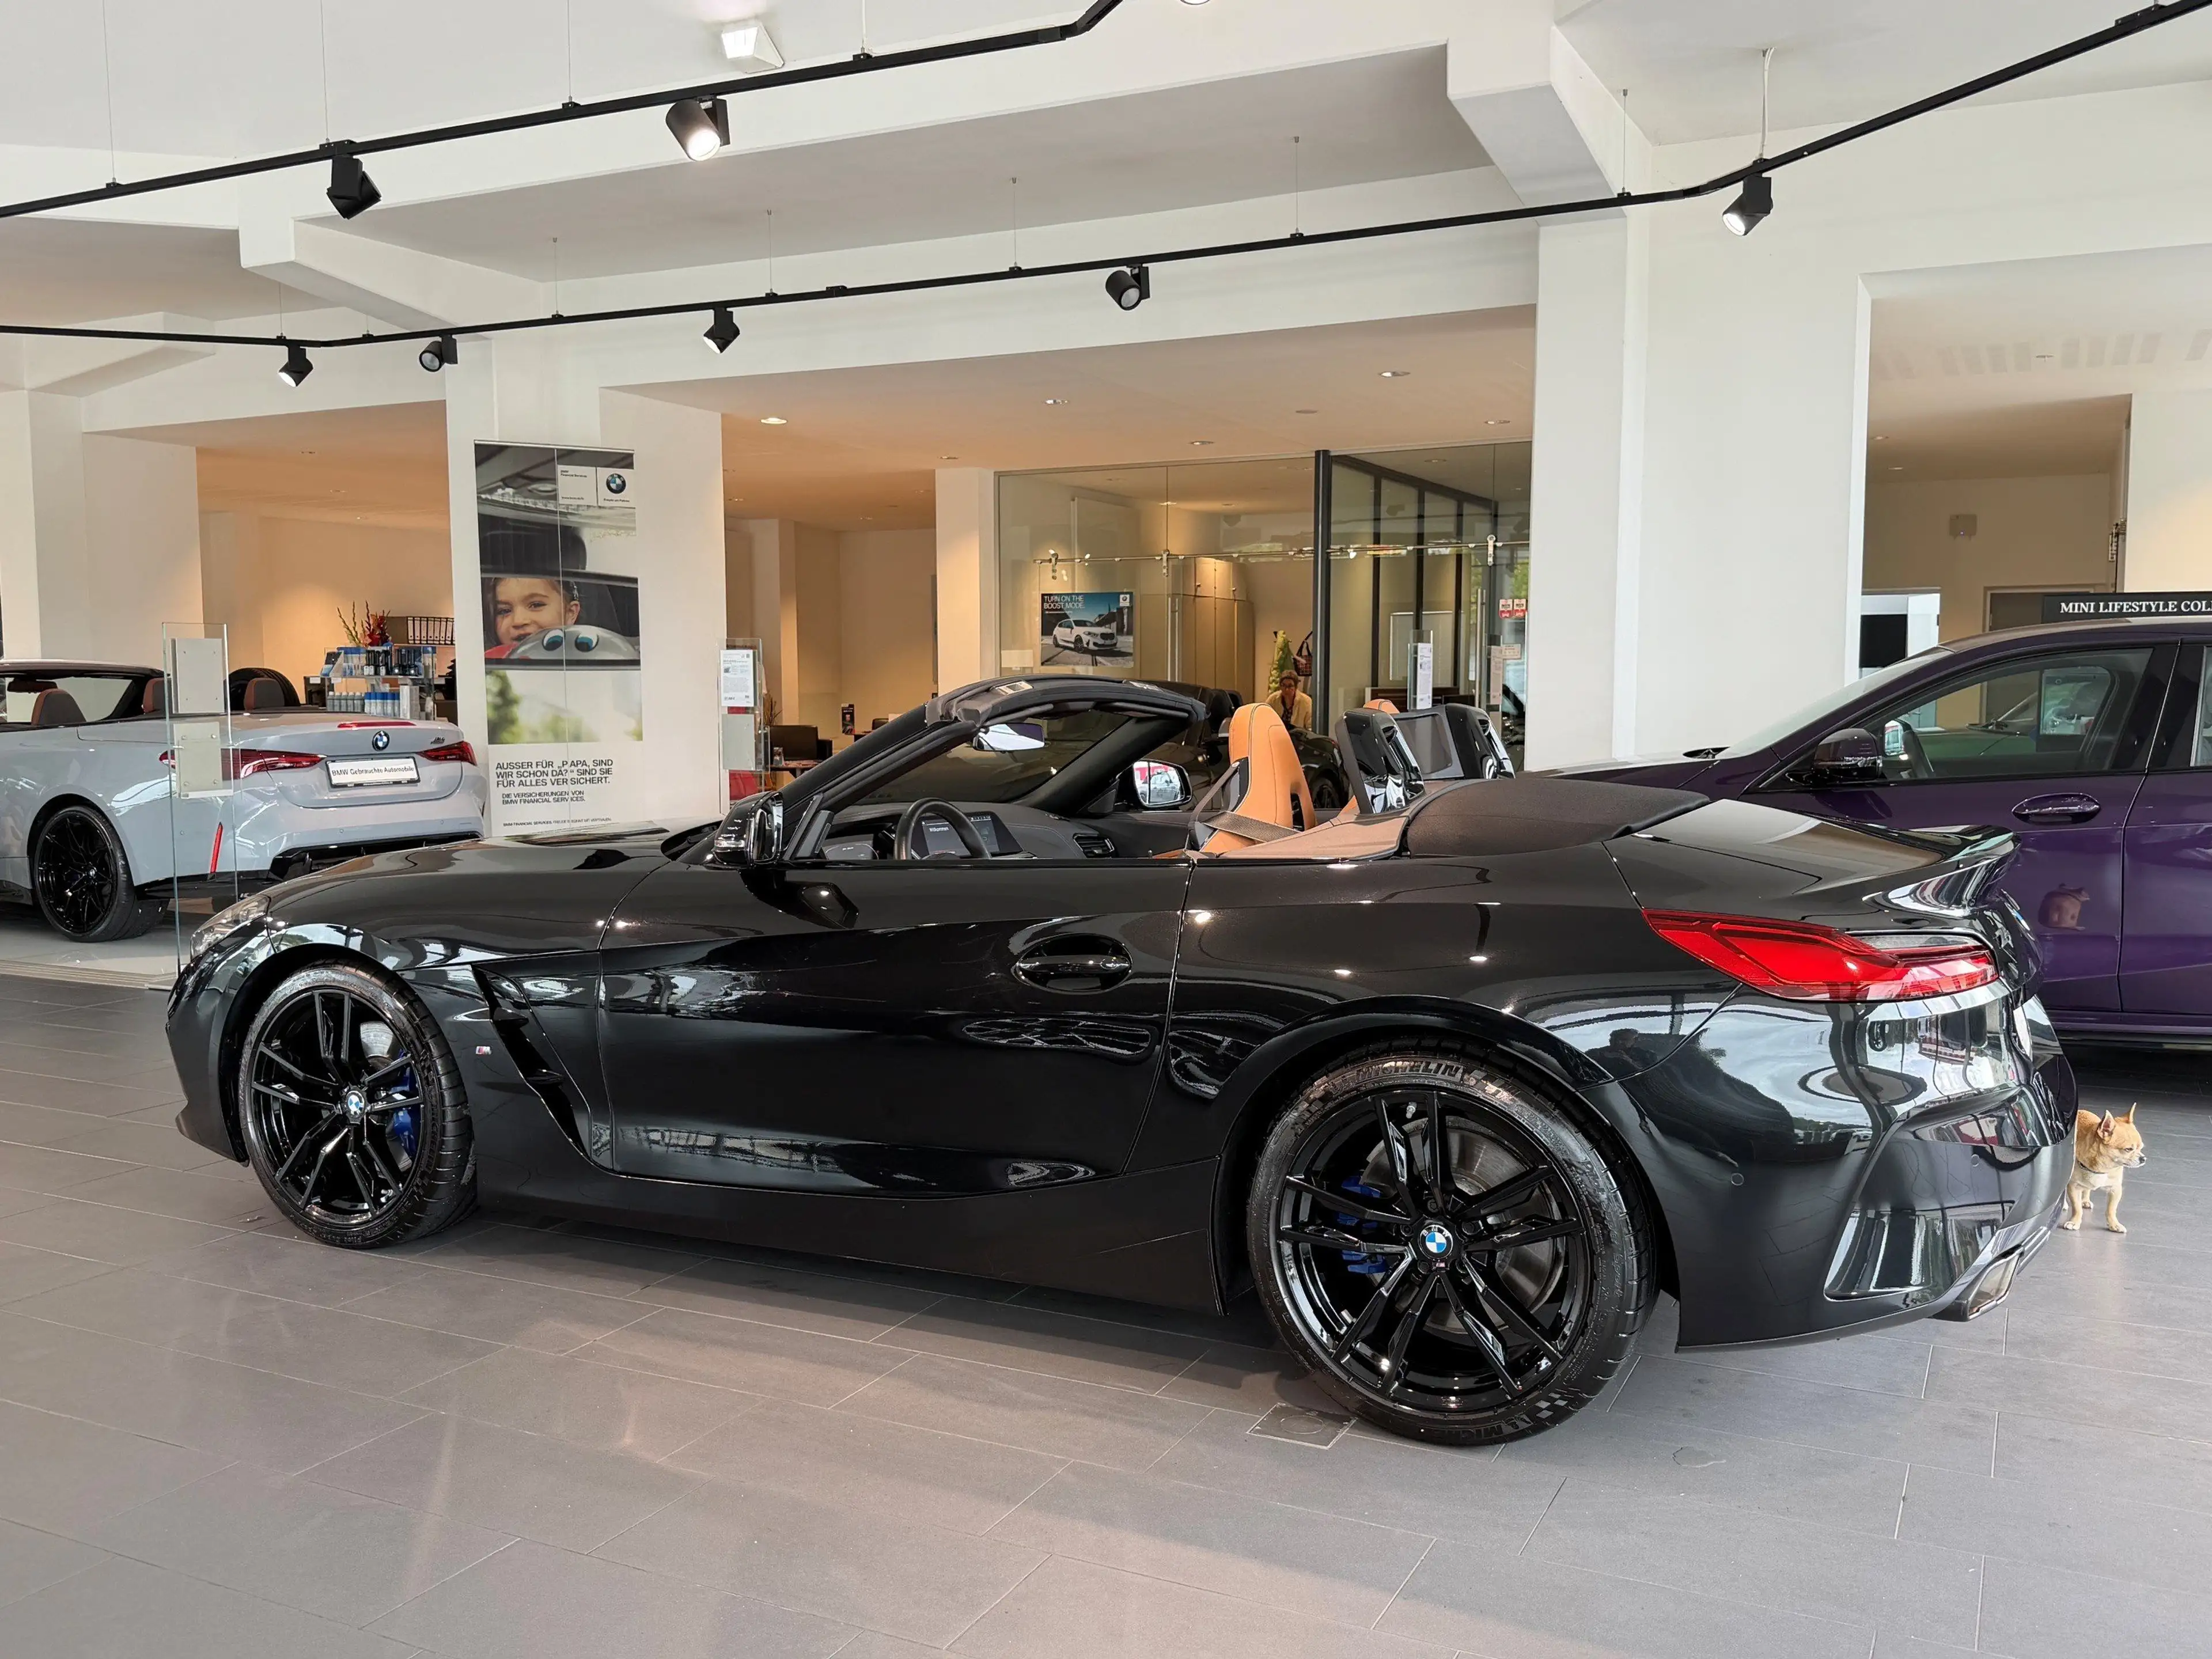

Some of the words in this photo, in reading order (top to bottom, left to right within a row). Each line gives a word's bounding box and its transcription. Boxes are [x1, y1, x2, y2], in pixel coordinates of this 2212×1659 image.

[2060, 602, 2095, 613] MINI
[2099, 601, 2177, 613] LIFESTYLE
[2180, 600, 2212, 612] COL
[496, 762, 533, 770] AUSSER
[536, 760, 554, 768] FÜR
[592, 759, 613, 767] SIND
[496, 771, 513, 779] WIR
[577, 768, 597, 776] SIND
[599, 767, 613, 775] SIE
[497, 778, 515, 788] FÜR
[518, 779, 547, 787] ALLES
[1356, 1060, 1462, 1081] MICHELIN
